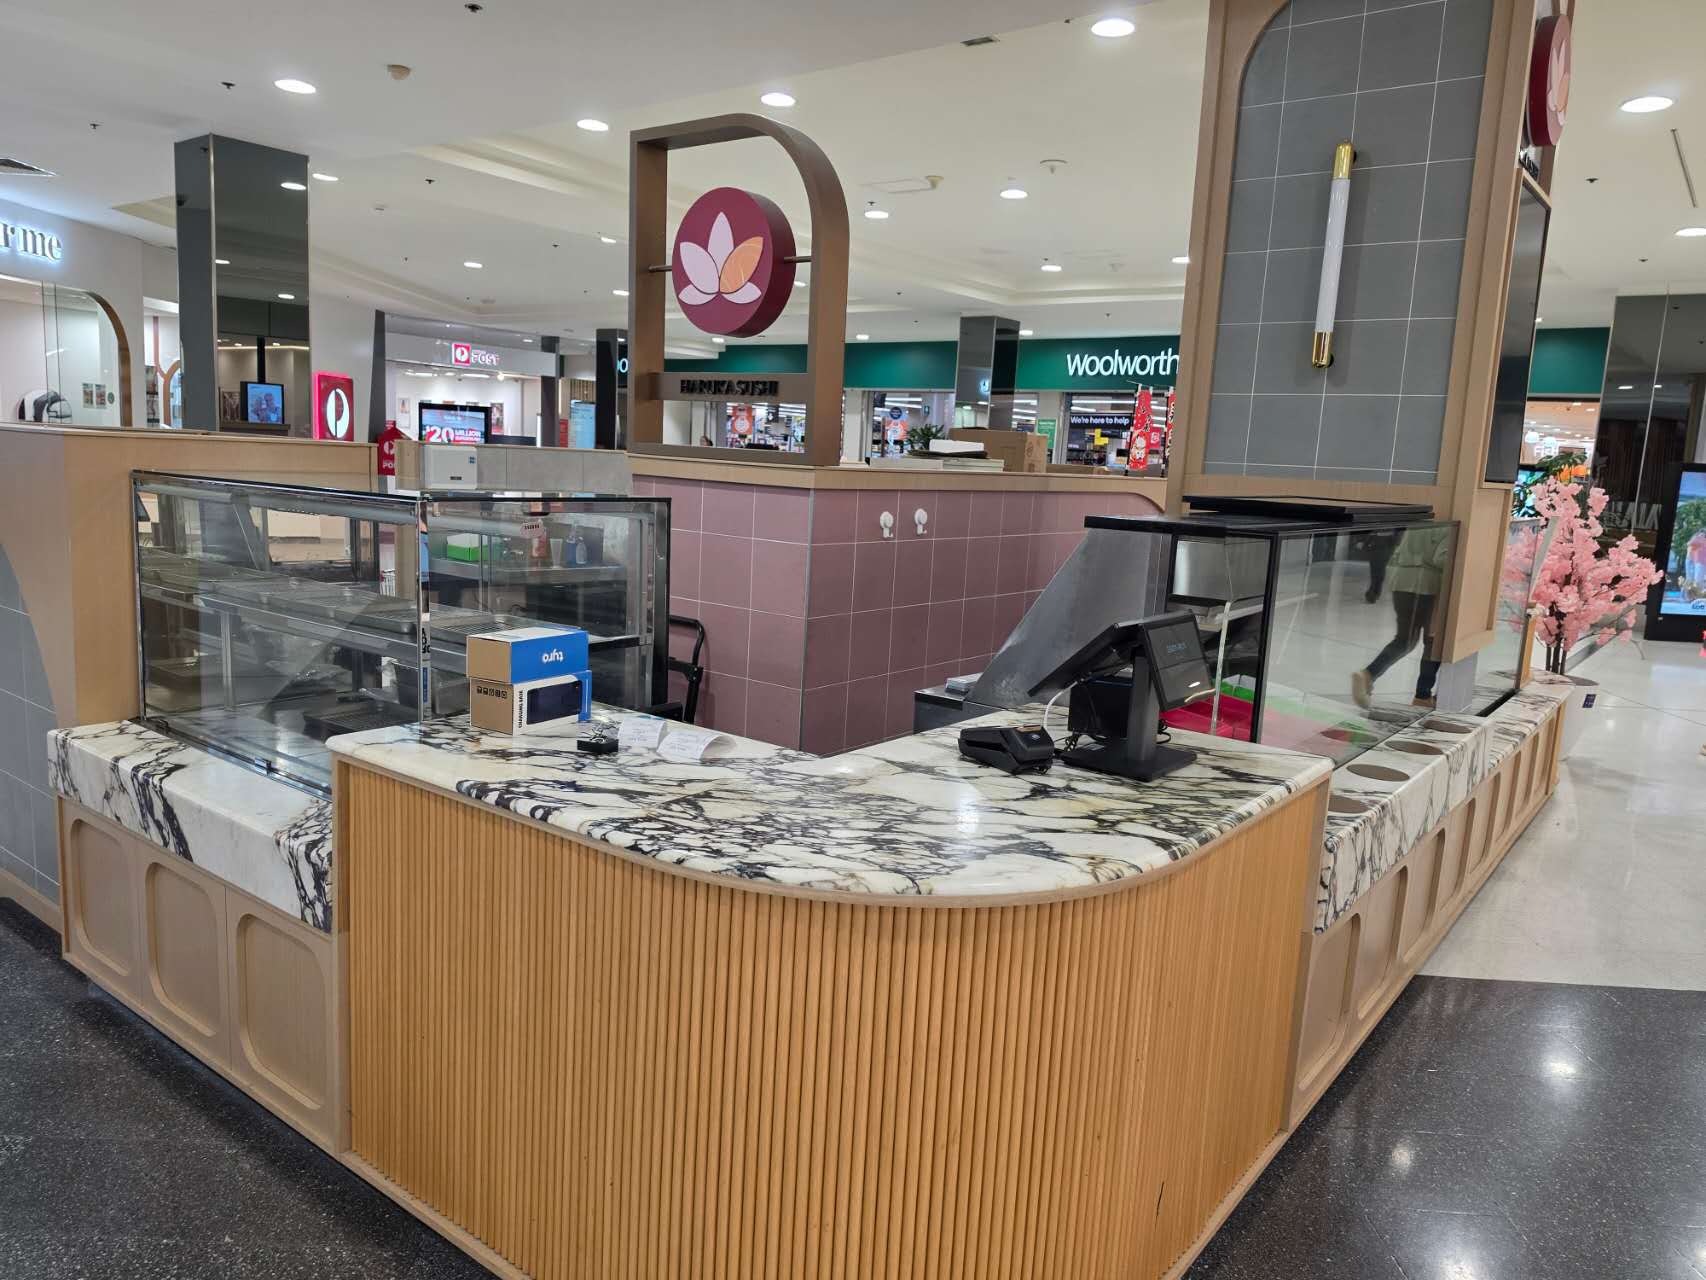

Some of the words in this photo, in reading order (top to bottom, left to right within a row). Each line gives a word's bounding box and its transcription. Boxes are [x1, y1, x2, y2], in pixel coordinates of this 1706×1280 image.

[1071, 416, 1089, 424] We're
[1090, 416, 1105, 424] here
[1106, 416, 1113, 424] to
[1114, 416, 1130, 425] help
[383, 461, 395, 469] PO
[541, 648, 564, 663] tyro
